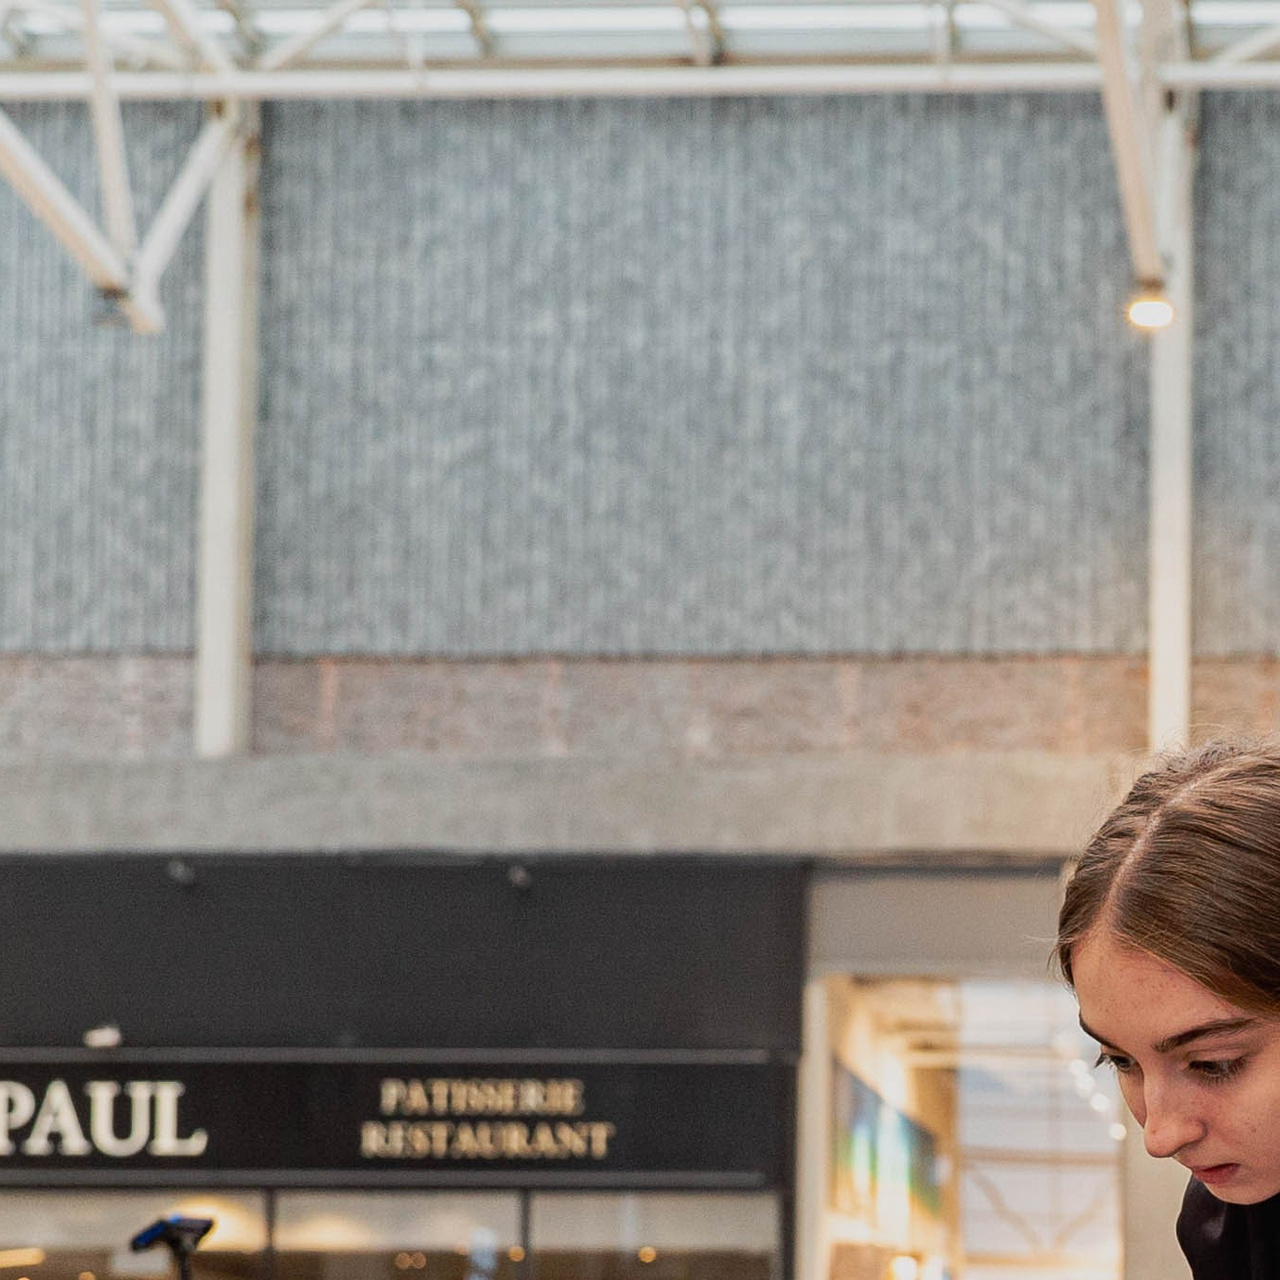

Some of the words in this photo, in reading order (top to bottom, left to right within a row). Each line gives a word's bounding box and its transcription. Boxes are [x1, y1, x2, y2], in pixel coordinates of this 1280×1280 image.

[380, 1078, 585, 1116] PATISSERIE
[0, 1079, 208, 1156] PAUL
[361, 1121, 616, 1158] RESTAURANT
